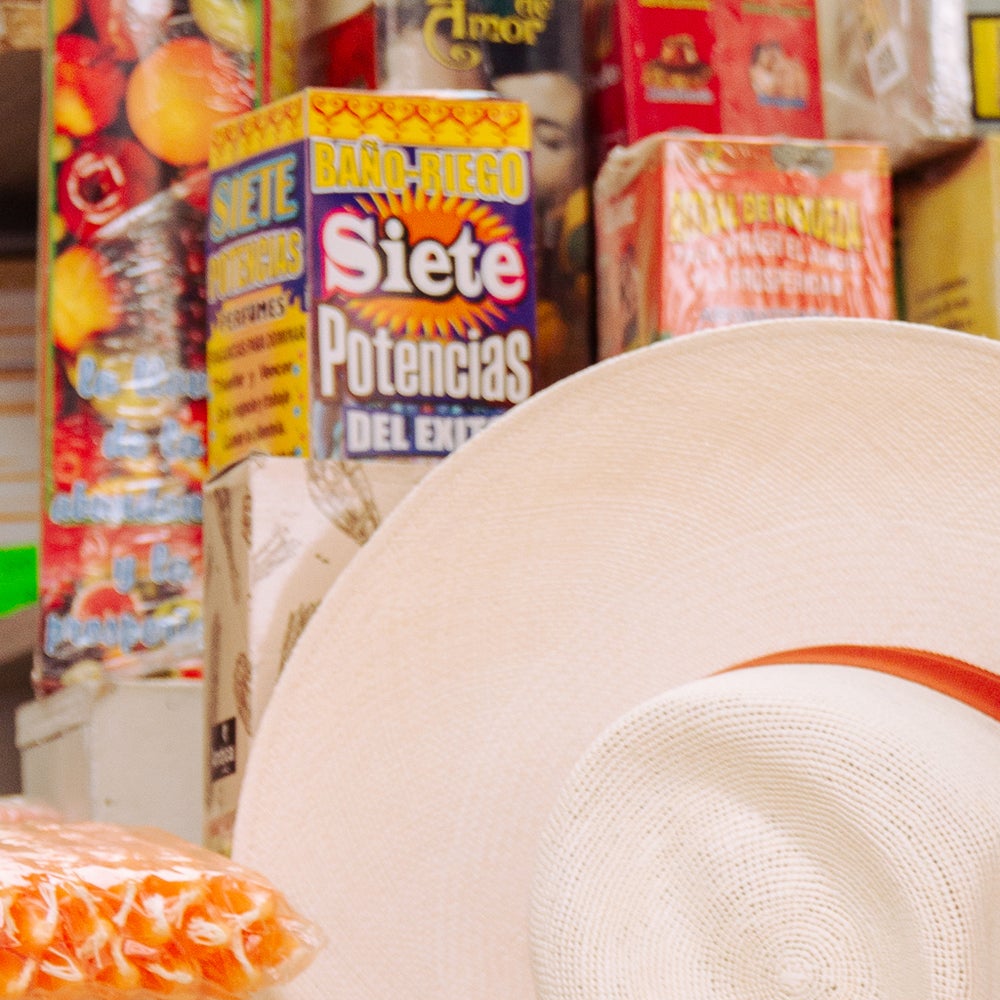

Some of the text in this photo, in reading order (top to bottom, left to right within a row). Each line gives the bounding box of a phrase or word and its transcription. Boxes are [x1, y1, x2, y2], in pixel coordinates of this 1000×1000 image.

[423, 0, 546, 70] Amor
[210, 155, 297, 240] SIETE
[313, 138, 523, 200] BAÑO-RIEGO
[321, 212, 525, 299] Siete
[318, 304, 532, 404] Potencias
[346, 411, 410, 451] DEL
